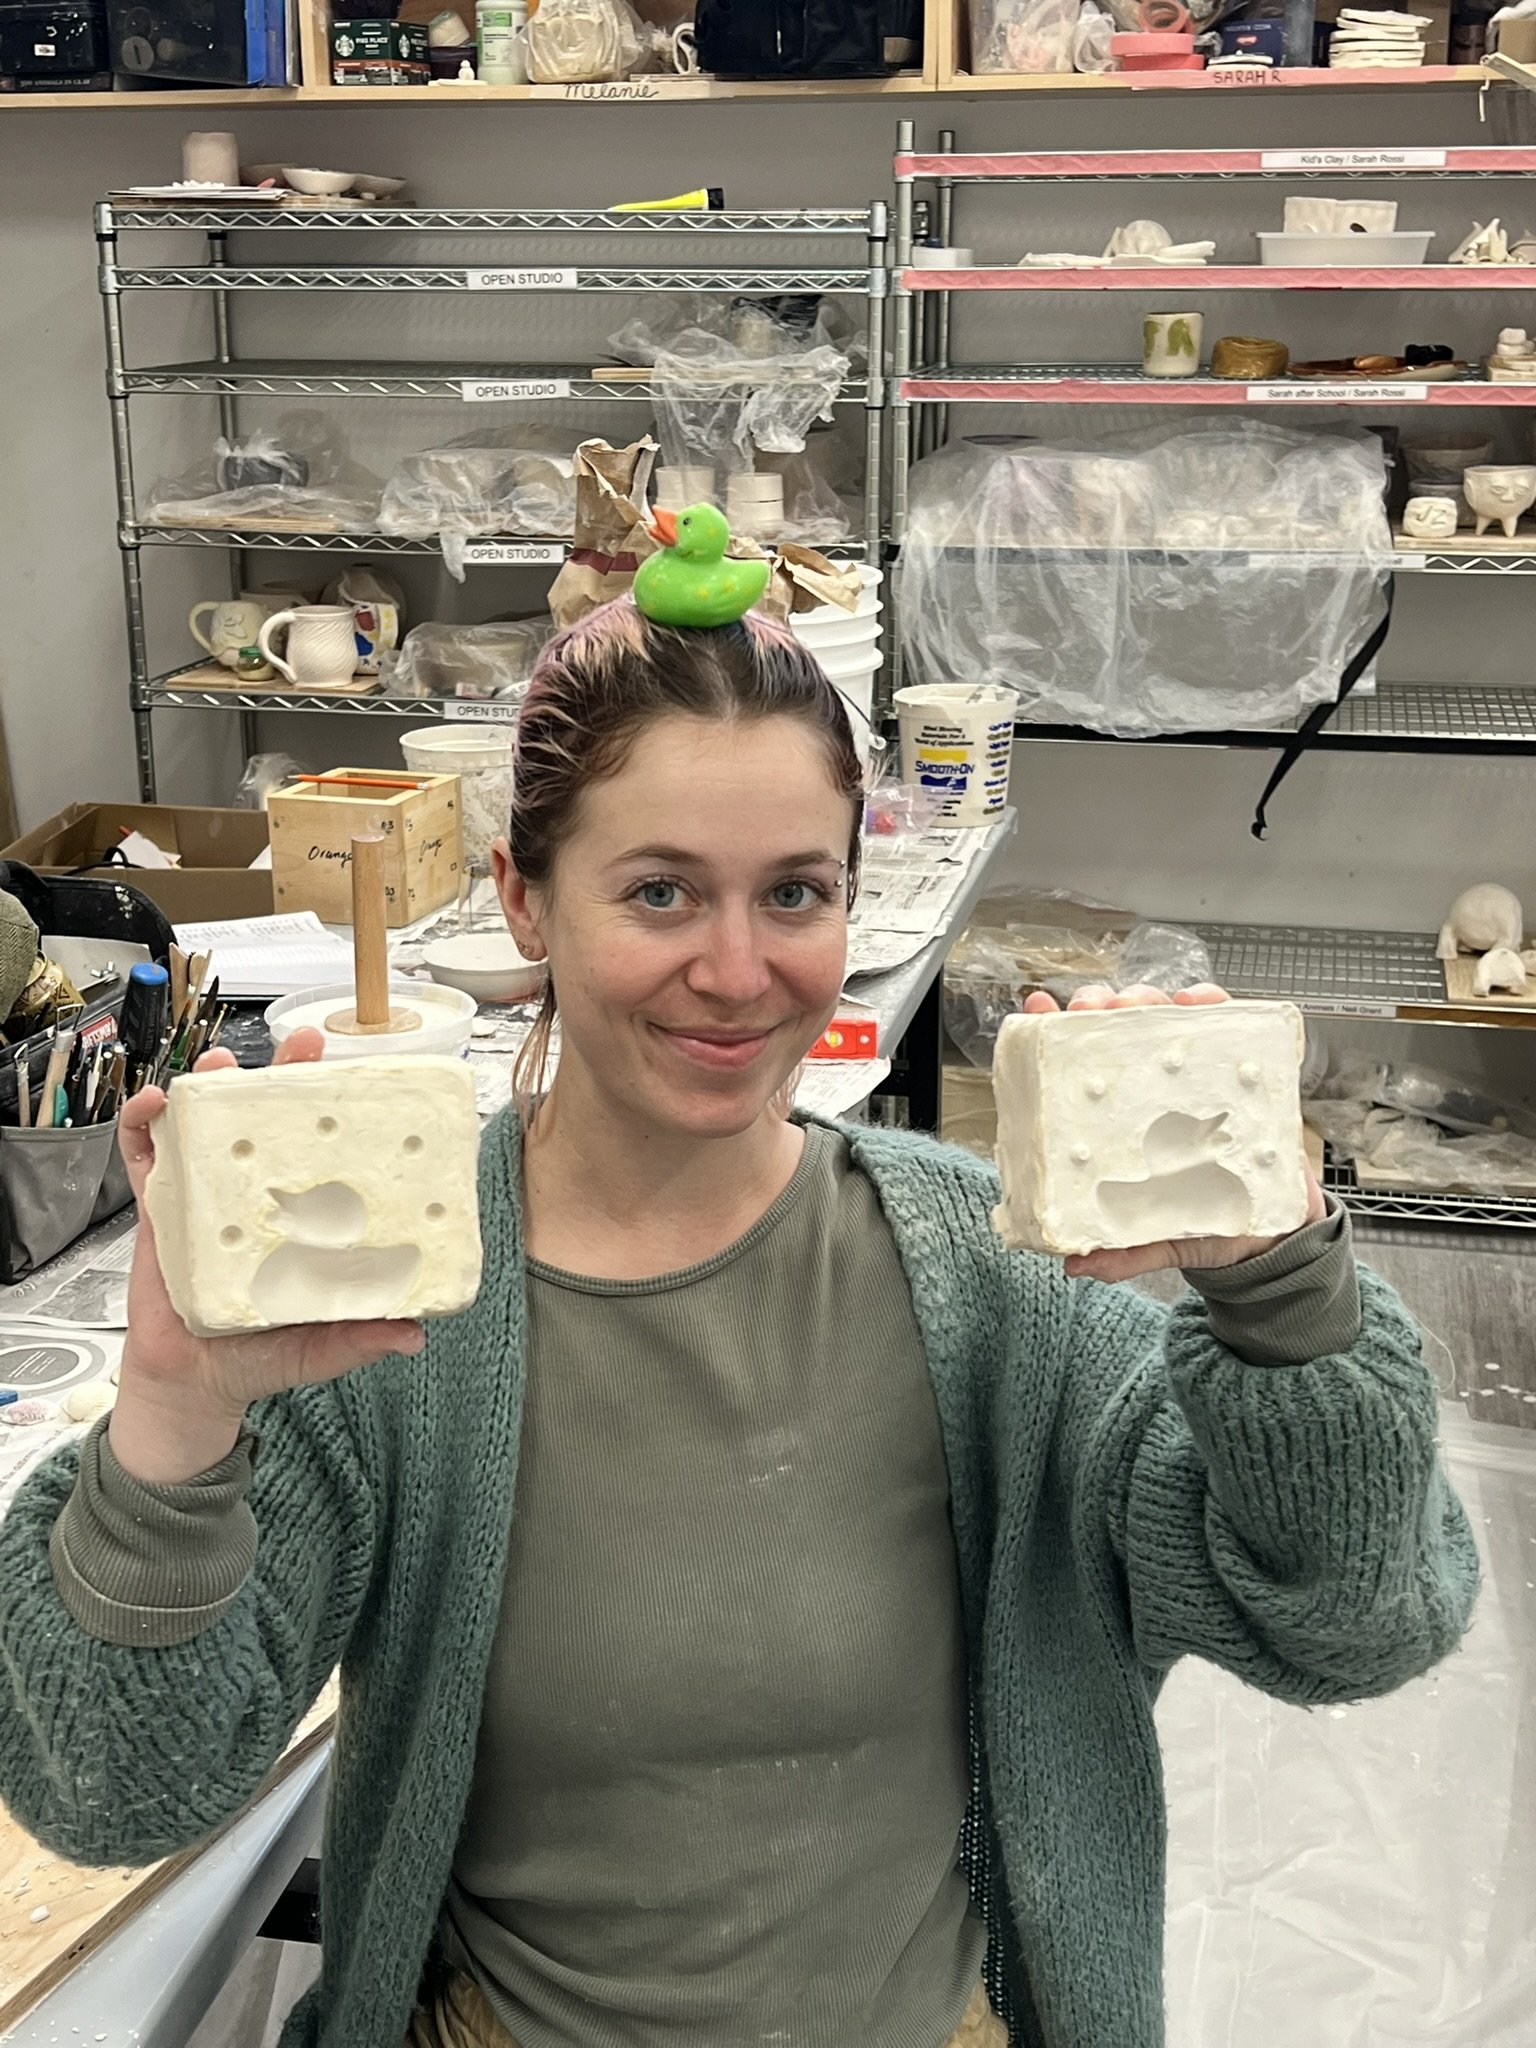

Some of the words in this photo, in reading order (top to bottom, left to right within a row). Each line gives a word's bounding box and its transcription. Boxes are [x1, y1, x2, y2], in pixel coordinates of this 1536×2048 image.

[1213, 70, 1266, 85] SARAH
[563, 83, 660, 99] Melanie
[1301, 154, 1322, 164] Kid's
[1324, 154, 1344, 166] Clay
[1351, 154, 1378, 164] Sarah
[1380, 153, 1405, 163] Rossi
[481, 274, 515, 286] OPEN
[518, 272, 563, 285] STUDIO
[475, 386, 509, 397] OPEN
[512, 383, 556, 396] STUDIO
[1267, 388, 1293, 398] Sarah
[1295, 388, 1315, 398] after
[1317, 388, 1346, 398] School
[1353, 388, 1379, 398] Sarah
[1381, 387, 1406, 397] Rossi
[471, 548, 504, 560] OPEN
[506, 548, 551, 560] STUDIO
[457, 705, 489, 717] OPEN
[491, 707, 520, 718] STU
